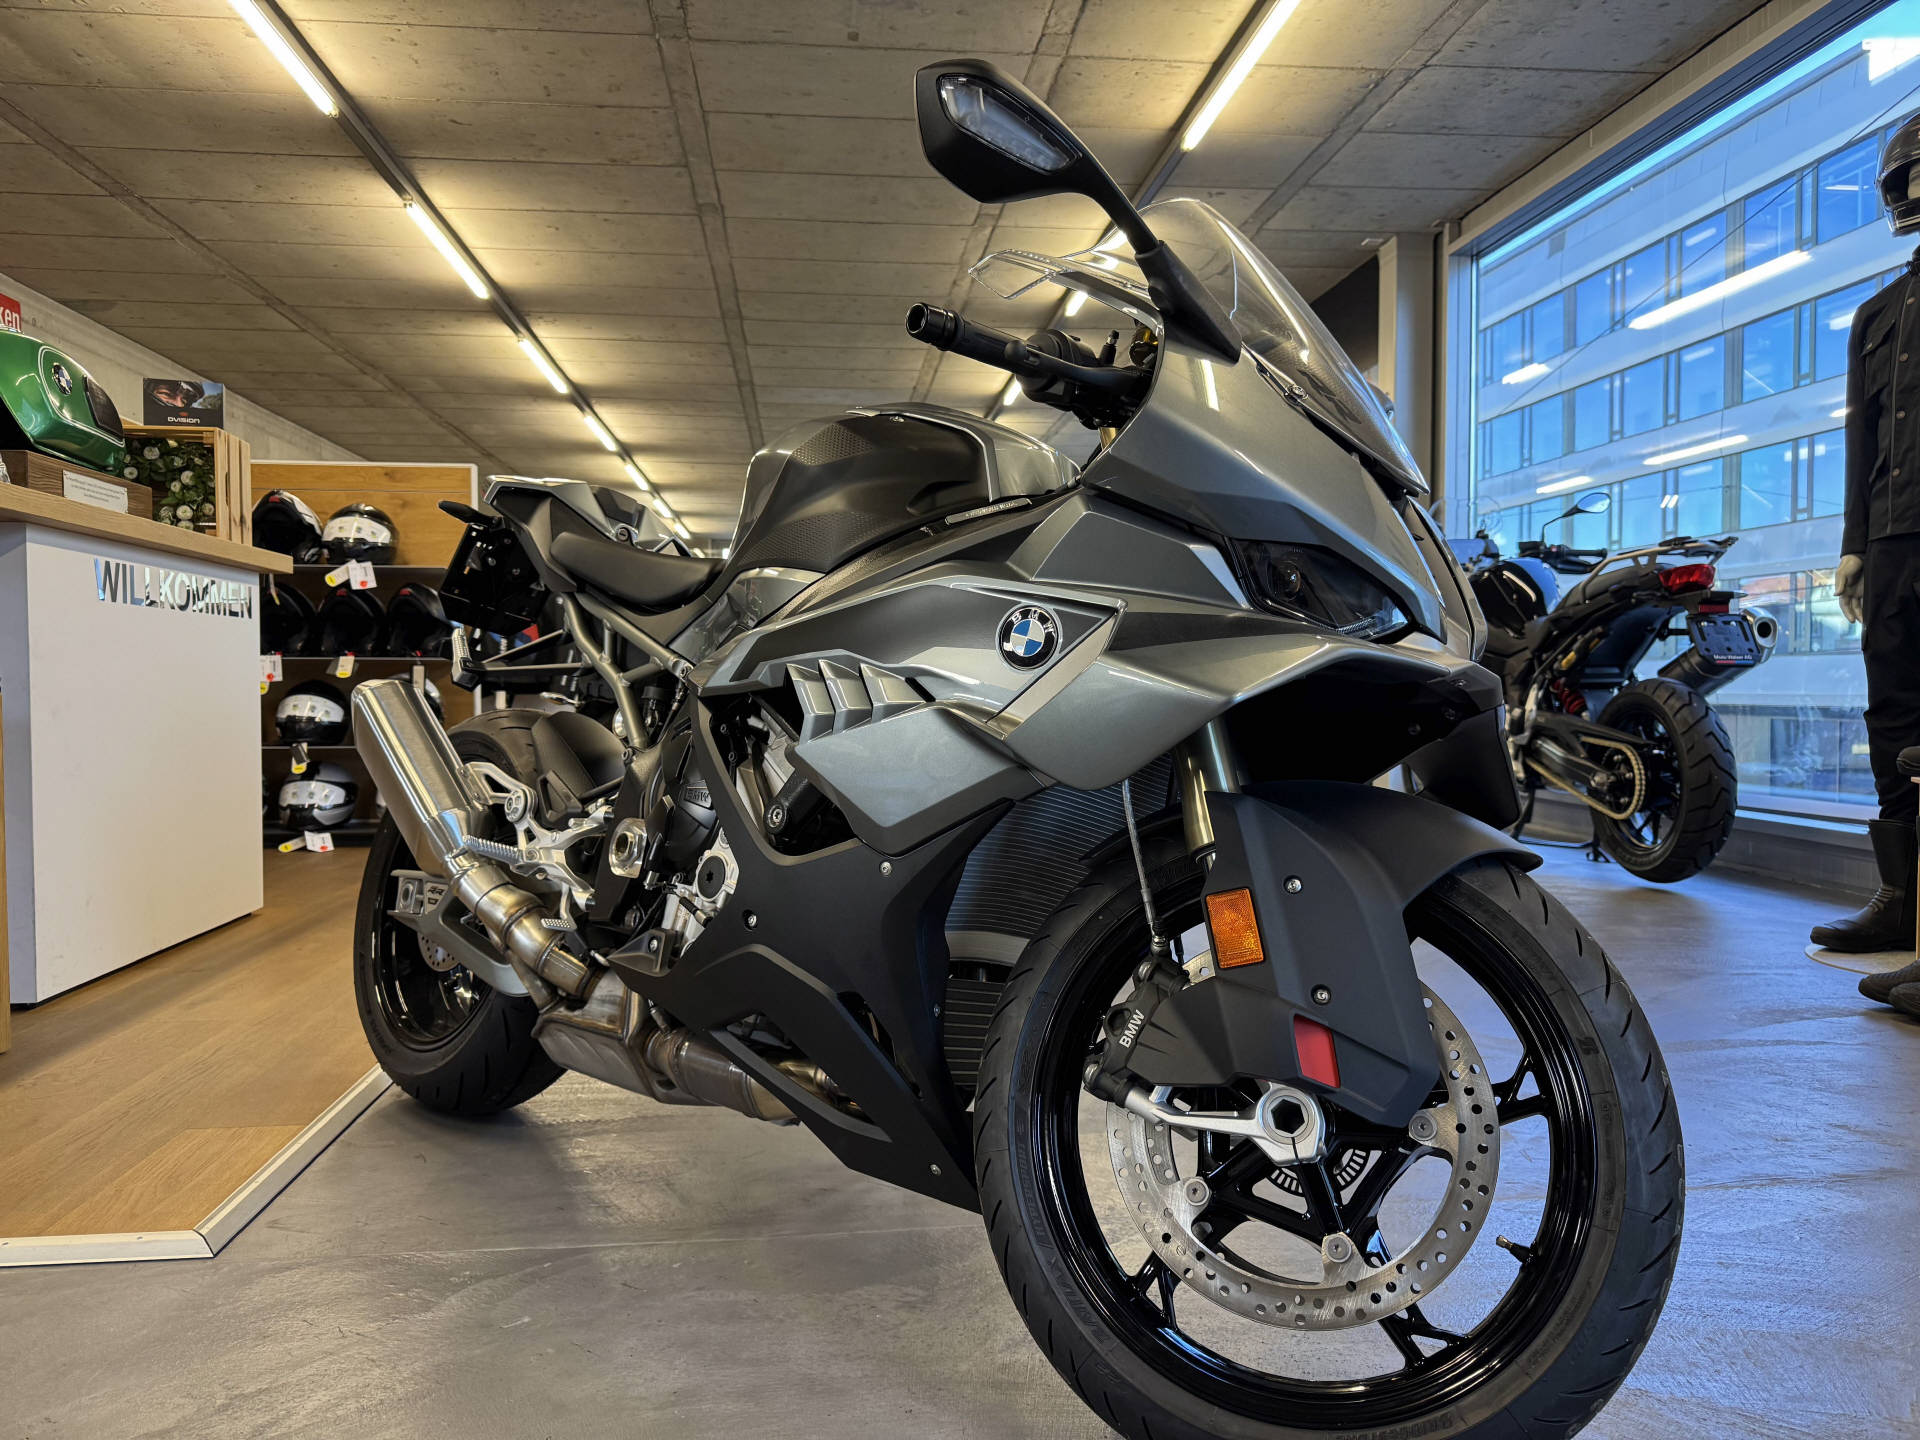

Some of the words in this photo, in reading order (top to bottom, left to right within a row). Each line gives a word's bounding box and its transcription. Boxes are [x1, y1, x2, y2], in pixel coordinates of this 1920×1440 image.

[94, 558, 253, 619] WILLKOMMEN
[1011, 607, 1055, 633] BMW
[1119, 1009, 1145, 1048] BMW
